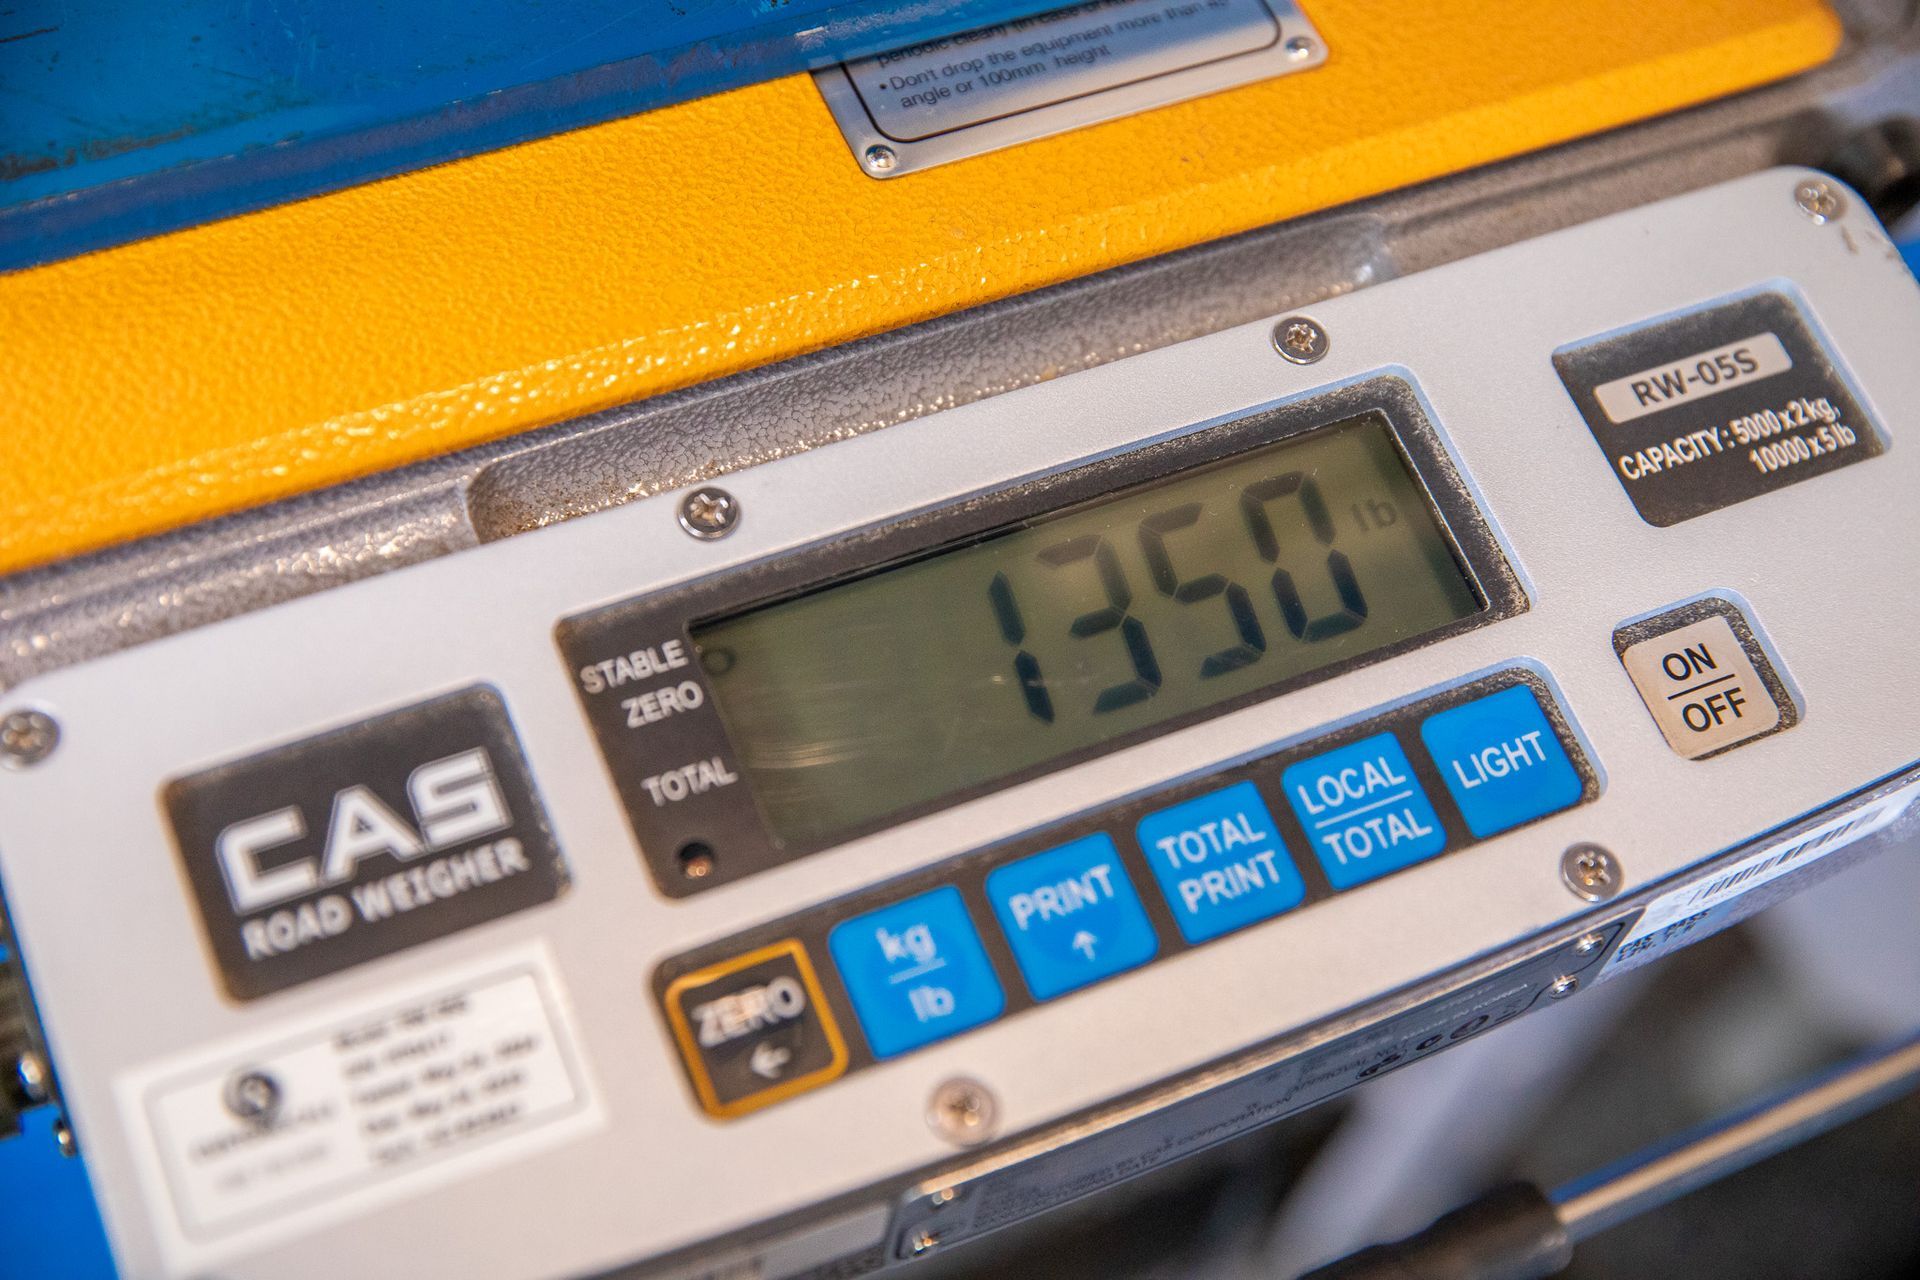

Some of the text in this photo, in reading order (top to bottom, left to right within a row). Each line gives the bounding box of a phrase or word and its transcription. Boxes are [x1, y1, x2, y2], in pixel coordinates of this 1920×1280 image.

[888, 68, 938, 91] Don't
[941, 57, 985, 77] drop
[986, 48, 1017, 65] the
[1022, 24, 1114, 57] equipment
[1116, 12, 1163, 33] more
[900, 43, 1112, 109] angle or 100mm height
[1630, 347, 1759, 407] RW-05S
[987, 469, 1369, 724] 1350
[580, 638, 689, 694] STABLE
[1661, 642, 1718, 682] ON
[621, 680, 705, 729] ZERO
[1681, 686, 1746, 733] OFF
[640, 755, 739, 807] TOTAL
[1297, 755, 1407, 815] LOCAL
[1451, 729, 1548, 789] LIGHT
[214, 746, 515, 916] CAS
[1155, 811, 1267, 870] TOTAL
[1321, 807, 1433, 865] TOTAL
[240, 836, 531, 962] ROAD WEIGHER
[1008, 863, 1116, 931] PRINT
[1178, 849, 1282, 914] PRINT
[875, 921, 937, 964] kg
[691, 975, 807, 1048] ZERO
[908, 984, 956, 1023] lb
